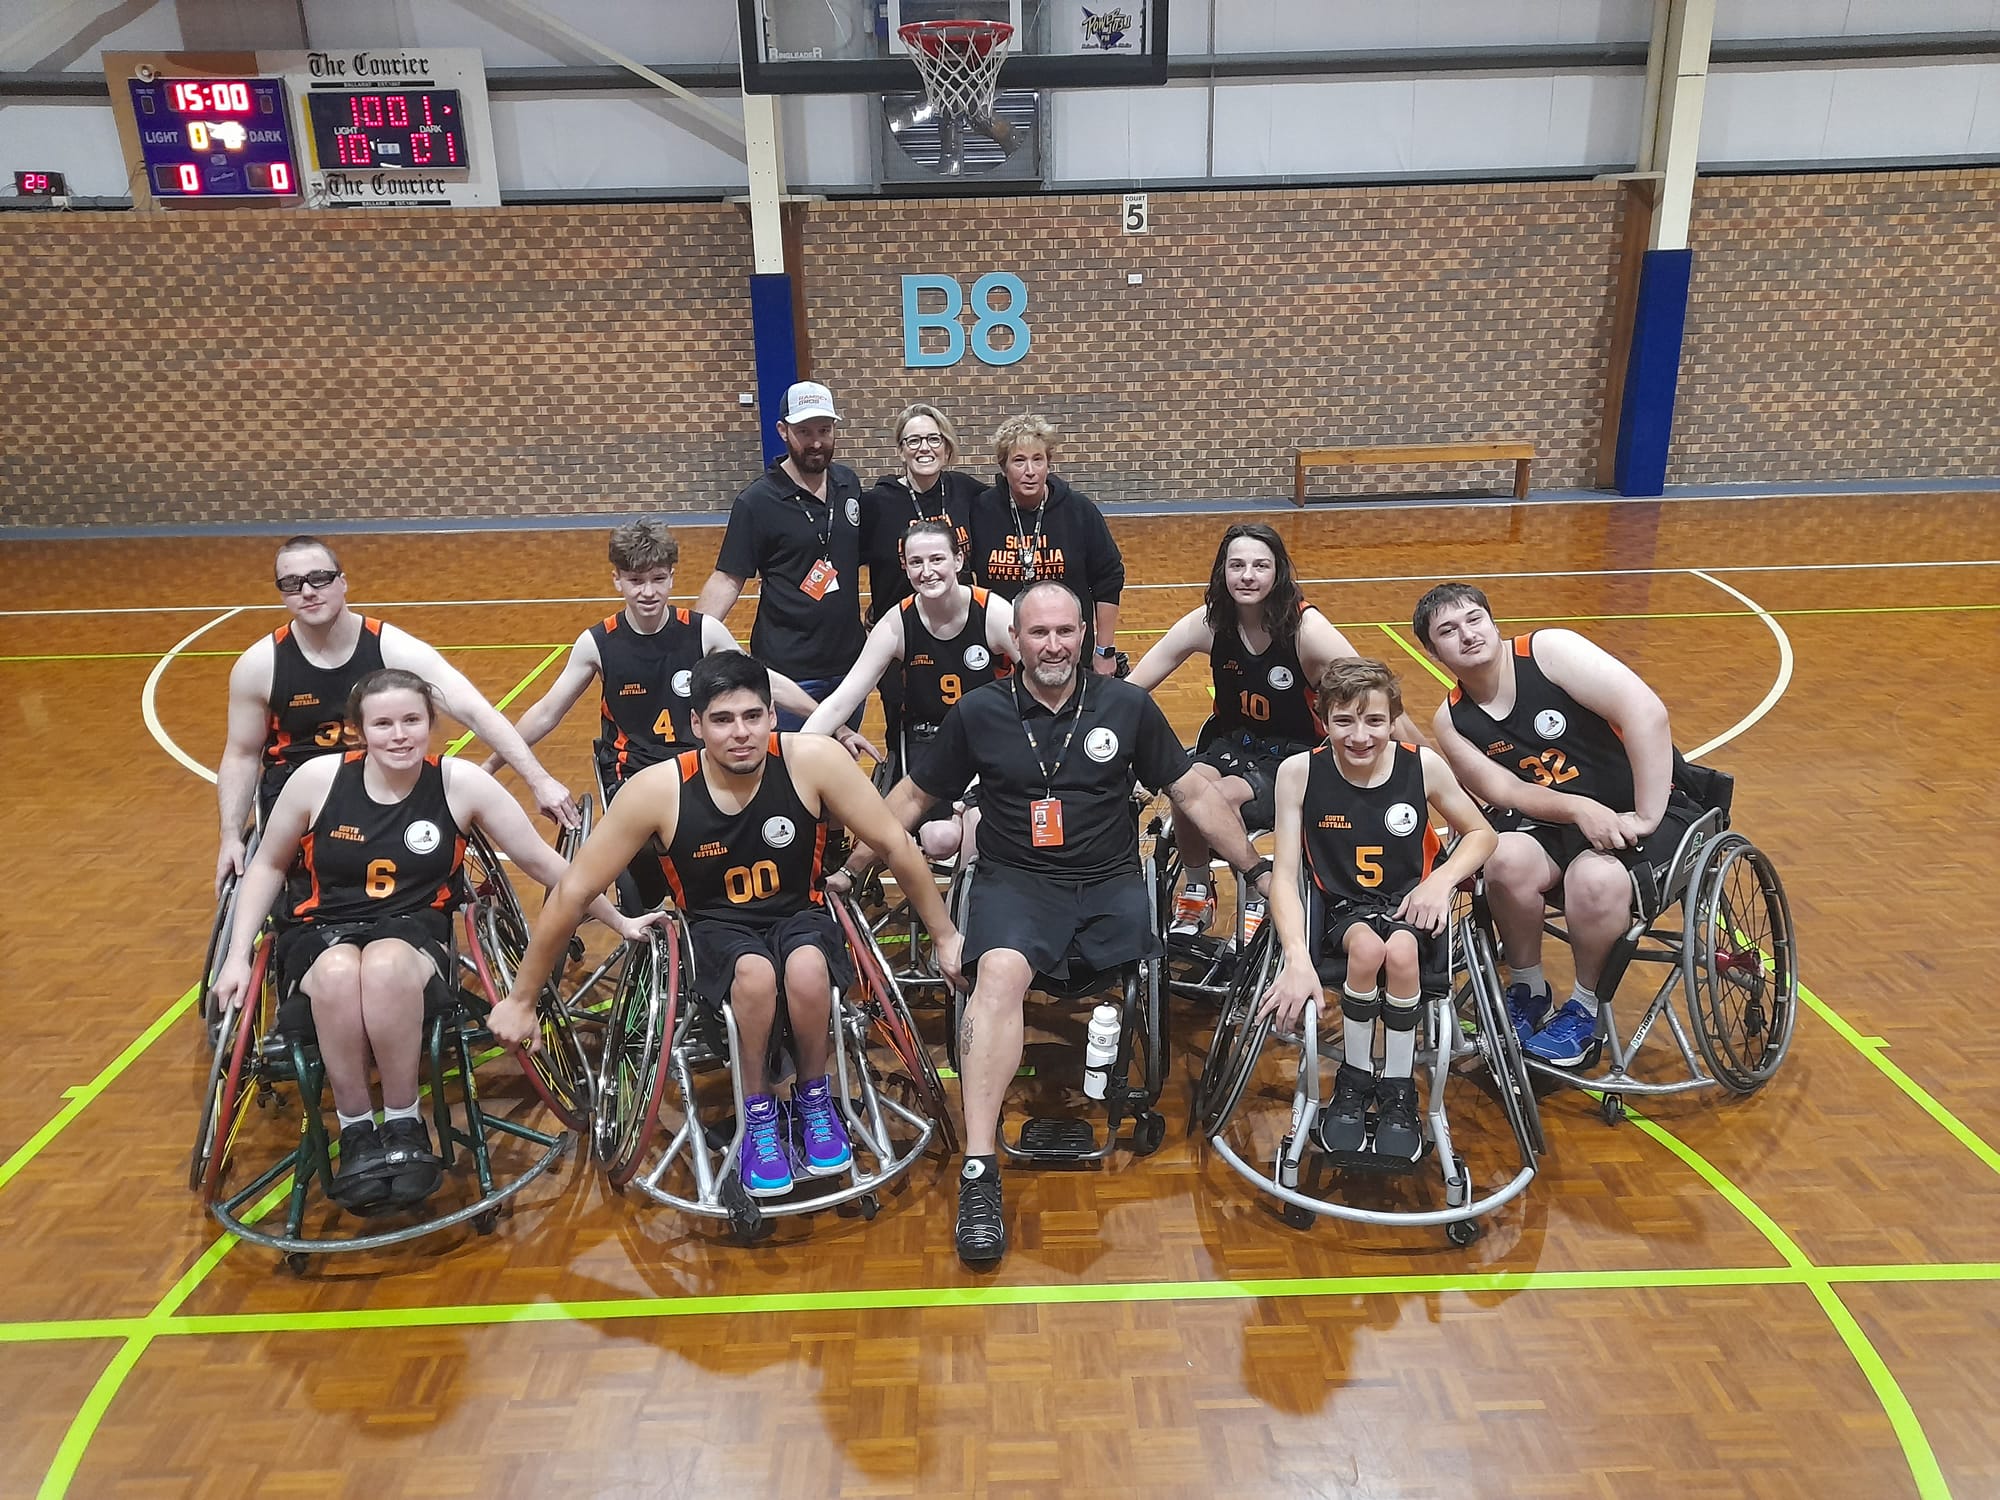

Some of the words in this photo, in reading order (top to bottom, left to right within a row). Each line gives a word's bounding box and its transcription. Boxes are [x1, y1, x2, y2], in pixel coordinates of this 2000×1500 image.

[307, 52, 346, 78] The
[353, 52, 430, 76] Courier
[176, 83, 249, 111] 15:00
[145, 131, 178, 144] LIGHT
[249, 130, 282, 142] DARK
[333, 127, 358, 135] LIGHT
[420, 125, 442, 133] DARK
[179, 164, 199, 190] 0
[270, 163, 289, 189] 0
[326, 173, 364, 197] The
[371, 172, 447, 196] Courier
[1126, 203, 1144, 230] 5
[901, 271, 1031, 367] B8
[940, 674, 962, 705] 9
[1239, 689, 1270, 721] 10
[652, 708, 676, 743] 4
[1518, 748, 1581, 787] 32
[1318, 821, 1352, 829] AUSTRALIA
[1324, 814, 1345, 822] SOUTH
[329, 830, 365, 842] AUSTRALIA
[699, 841, 721, 851] SOUTH
[692, 846, 728, 858] AUSTRALIA
[365, 858, 397, 899] 6
[1355, 846, 1384, 888] 5
[724, 859, 780, 904] 00
